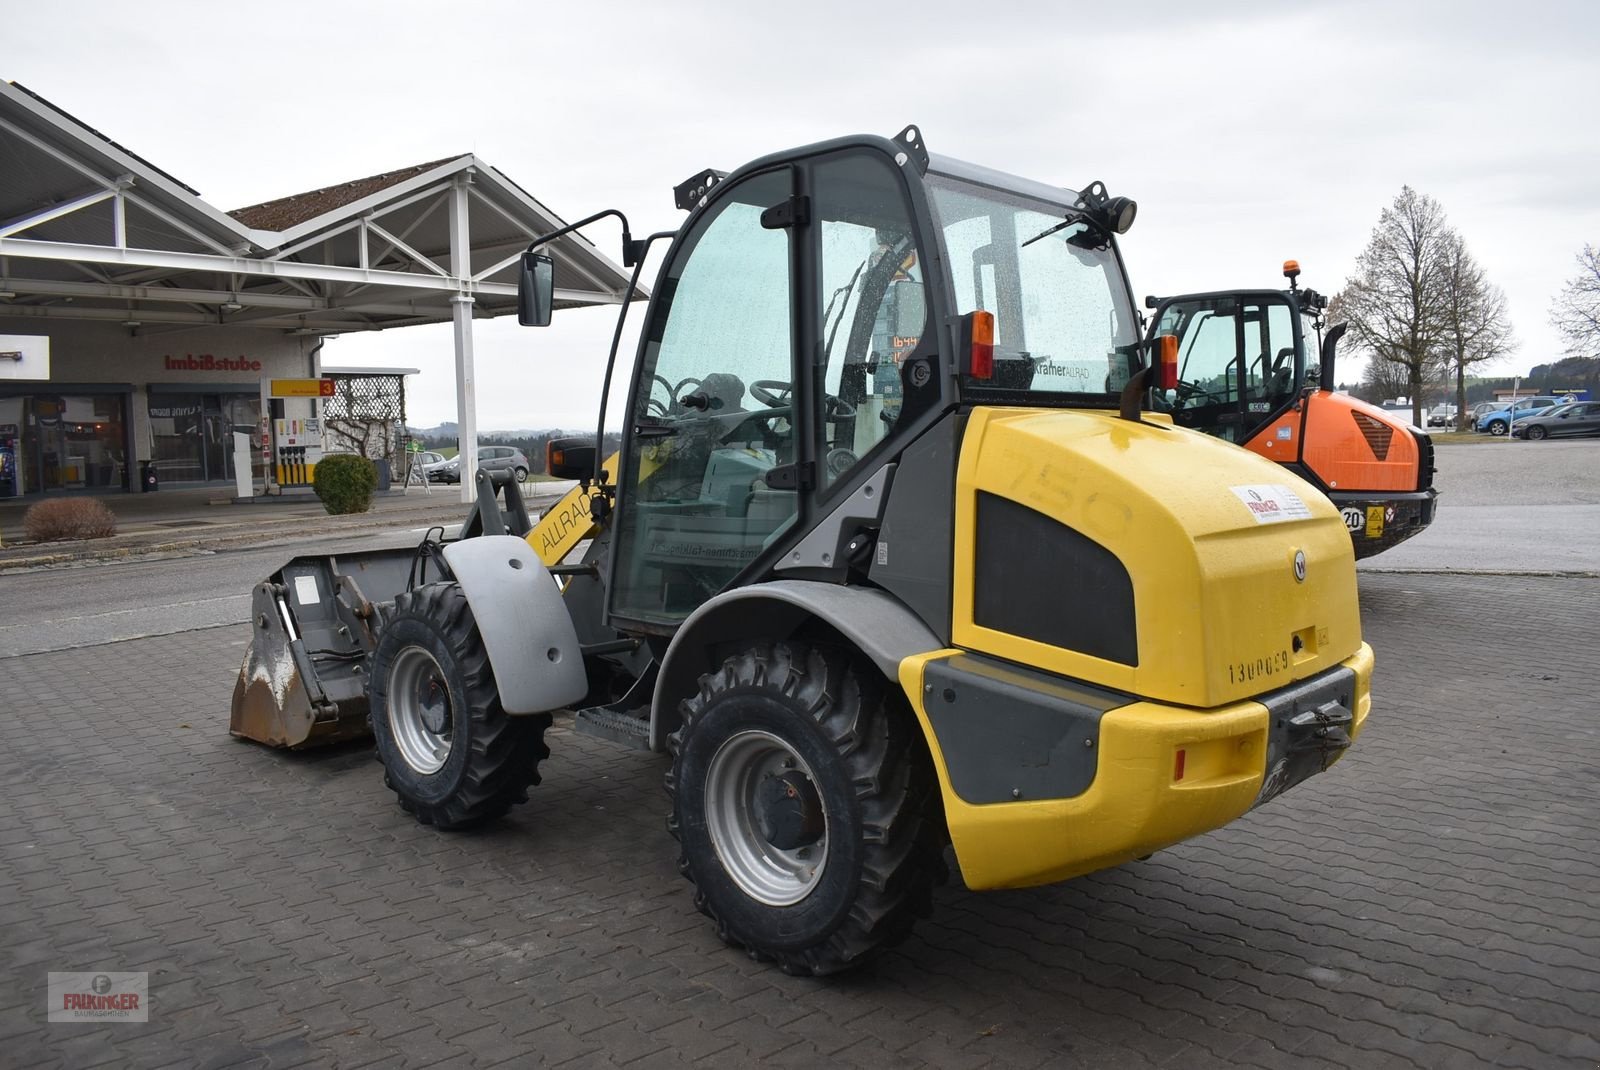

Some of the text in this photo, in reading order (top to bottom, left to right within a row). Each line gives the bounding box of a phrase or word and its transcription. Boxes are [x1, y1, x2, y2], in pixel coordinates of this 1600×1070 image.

[164, 354, 261, 372] Imbißstube
[323, 382, 333, 395] 3
[541, 493, 592, 556] ALLRAD
[1343, 511, 1360, 529] 20
